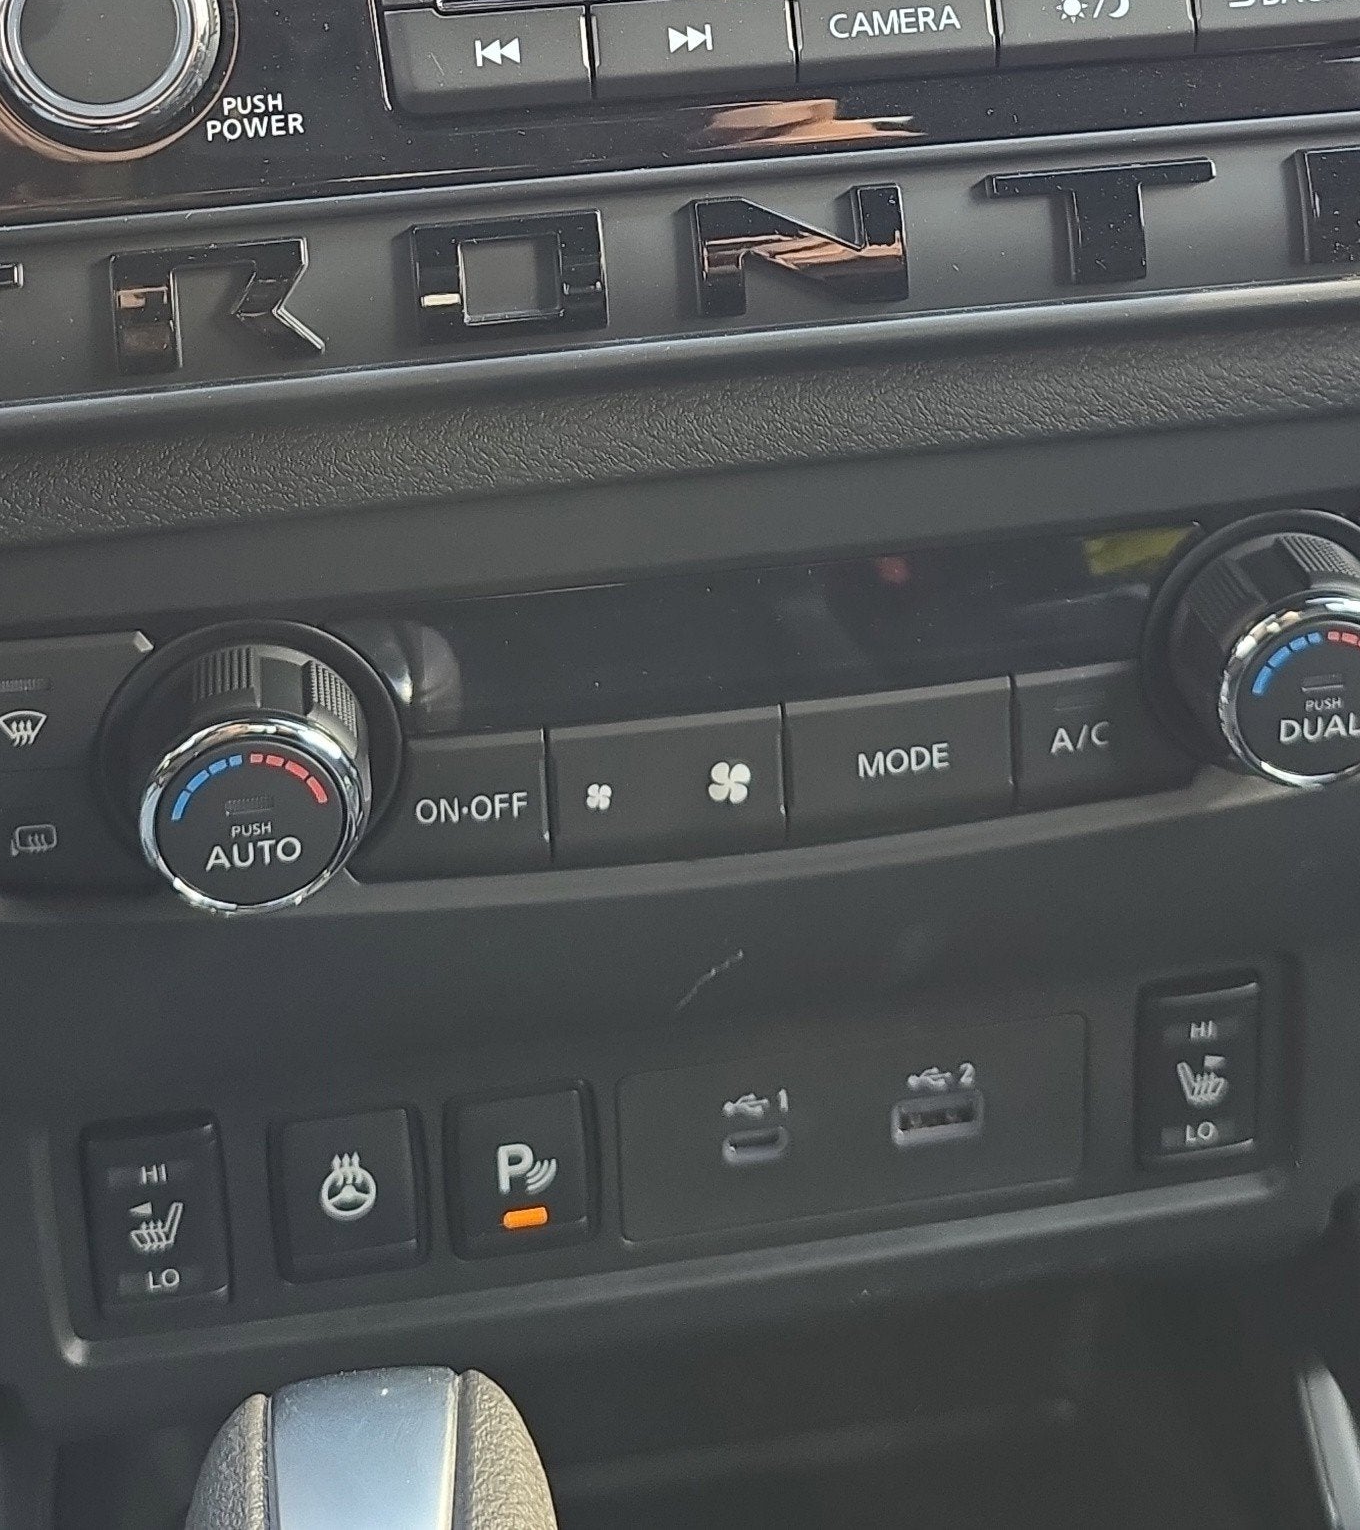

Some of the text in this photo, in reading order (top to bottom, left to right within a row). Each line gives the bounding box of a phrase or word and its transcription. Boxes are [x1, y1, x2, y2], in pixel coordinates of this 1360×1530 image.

[829, 4, 960, 39] CAMERA
[222, 93, 283, 116] PUSH
[206, 113, 304, 142] POWER
[1305, 697, 1343, 712] PUSH
[1051, 721, 1110, 756] A/C
[857, 742, 950, 779] MODE
[230, 820, 272, 838] PUSH
[206, 835, 301, 871] AUTO
[1190, 1020, 1219, 1041] HI
[959, 1062, 977, 1089] 2
[778, 1088, 789, 1113] 1
[1185, 1121, 1219, 1145] LO
[140, 1163, 168, 1186] HI
[497, 1143, 534, 1194] P
[148, 1268, 180, 1292] LO
